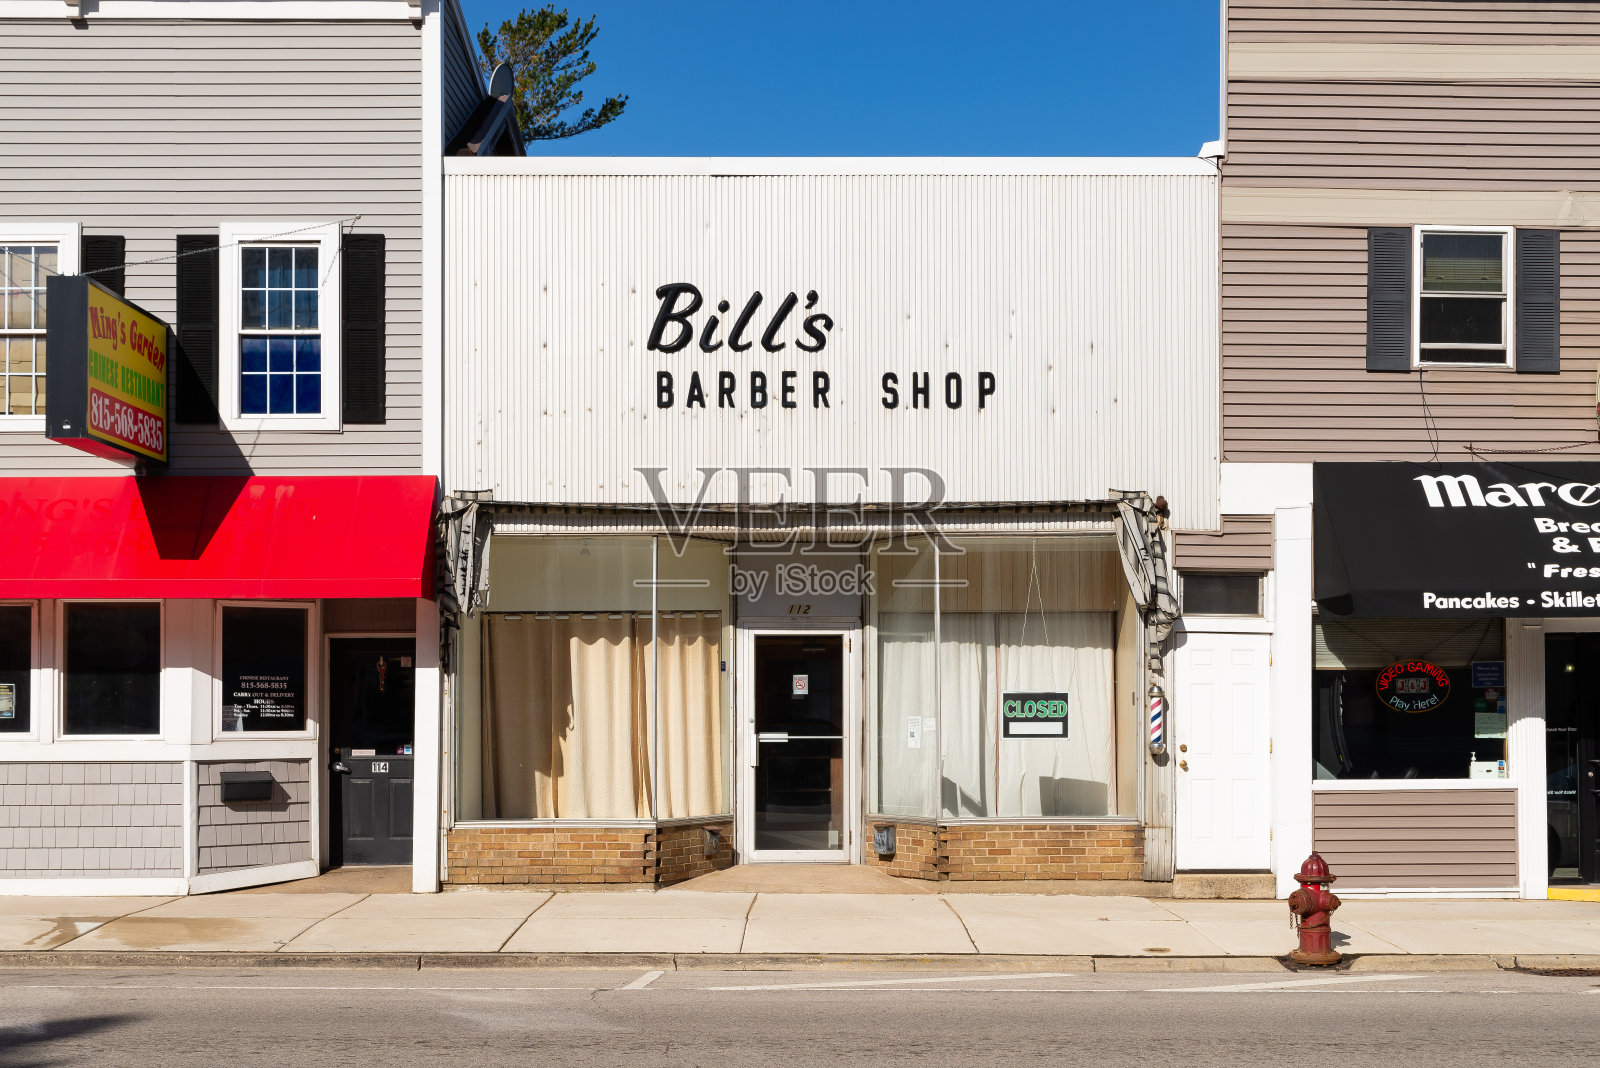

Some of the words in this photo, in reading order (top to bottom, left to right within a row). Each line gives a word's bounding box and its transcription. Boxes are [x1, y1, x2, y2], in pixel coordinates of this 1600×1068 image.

[646, 282, 834, 354] Bill's
[89, 305, 126, 351] Ming's
[130, 319, 165, 373] Garden
[88, 348, 119, 389] CHINESE
[121, 365, 165, 409] RESTAURANT
[656, 370, 830, 410] BARBER
[881, 371, 996, 410] SHOP
[91, 392, 163, 451] 815-568-5835
[1552, 536, 1581, 553] &
[1423, 591, 1520, 609] Pancakes
[789, 604, 811, 615] 112
[241, 681, 288, 689] 815-568-5835
[1379, 664, 1404, 691] VIDEO
[1407, 662, 1449, 687] GAMING
[1003, 700, 1068, 718] CLOSED
[1389, 695, 1410, 712] Play
[1413, 694, 1440, 710] Here!
[372, 762, 388, 773] 114
